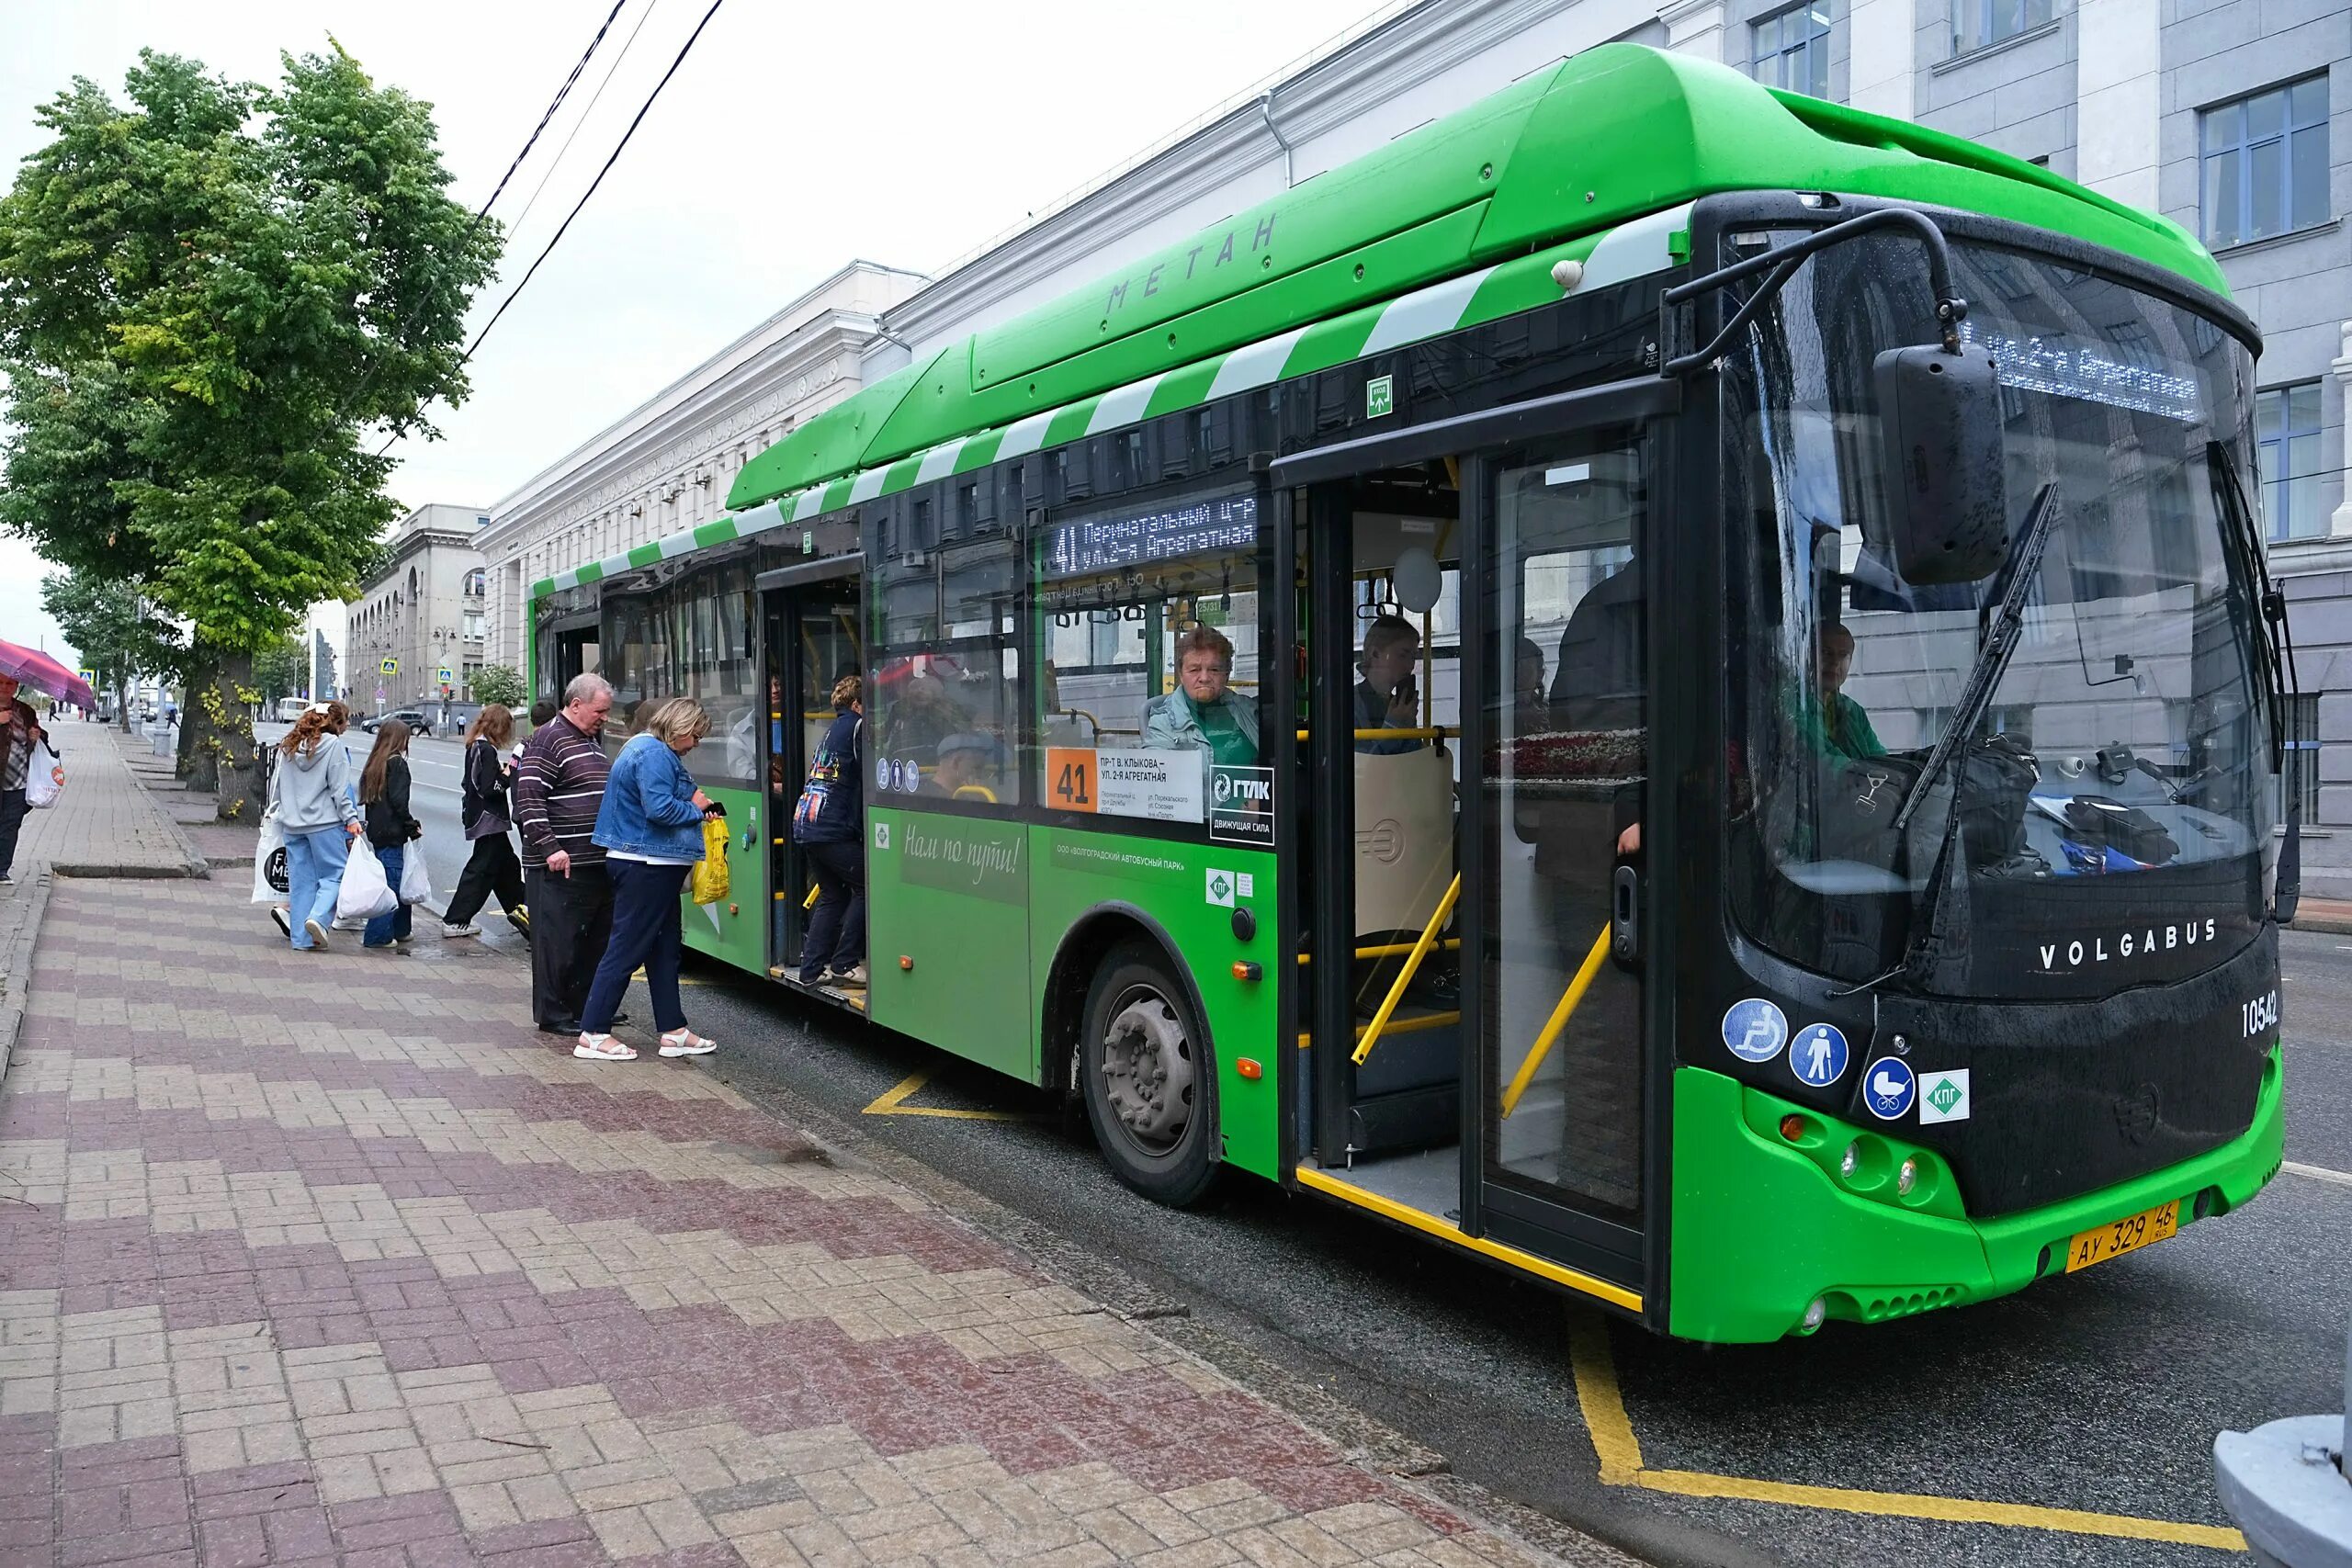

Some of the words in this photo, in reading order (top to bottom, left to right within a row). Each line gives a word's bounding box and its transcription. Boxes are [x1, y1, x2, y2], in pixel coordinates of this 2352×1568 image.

[1106, 212, 1275, 314] МЕТАН
[1084, 502, 1210, 544] Перинатальный
[1056, 525, 1077, 573] 41
[1147, 525, 1252, 557] Агрегатная
[1101, 757, 1115, 767] ПР-Т
[1124, 758, 1159, 769] КЛЫКОВА
[1102, 770, 1112, 780] УЛ.
[1113, 771, 1123, 780] 2-Я
[1124, 772, 1167, 783] АГРЕГАТНАЯ
[1057, 763, 1089, 805] 41
[1233, 779, 1270, 800] ГТЛК
[1214, 819, 1250, 832] ДВИЖУЩАЯ
[1252, 823, 1270, 833] СИЛА
[905, 824, 938, 860] Нам
[944, 838, 963, 863] по
[967, 836, 1021, 885] пути!
[1057, 844, 1069, 854] ООО
[1070, 846, 1120, 862] «ВОЛГОГРАДСКИЙ
[1121, 854, 1162, 869] АВТОБУСНЫЙ
[1163, 861, 1184, 872] ПАРК»
[1214, 882, 1227, 894] КПГ
[2040, 919, 2215, 969] VOLGABUS
[2242, 989, 2278, 1038] 10542
[1934, 1088, 1955, 1105] КПГ
[2076, 1235, 2103, 1265] АУ
[2109, 1214, 2146, 1253] 329
[2155, 1203, 2173, 1228] 46
[2154, 1226, 2168, 1238] RUS
